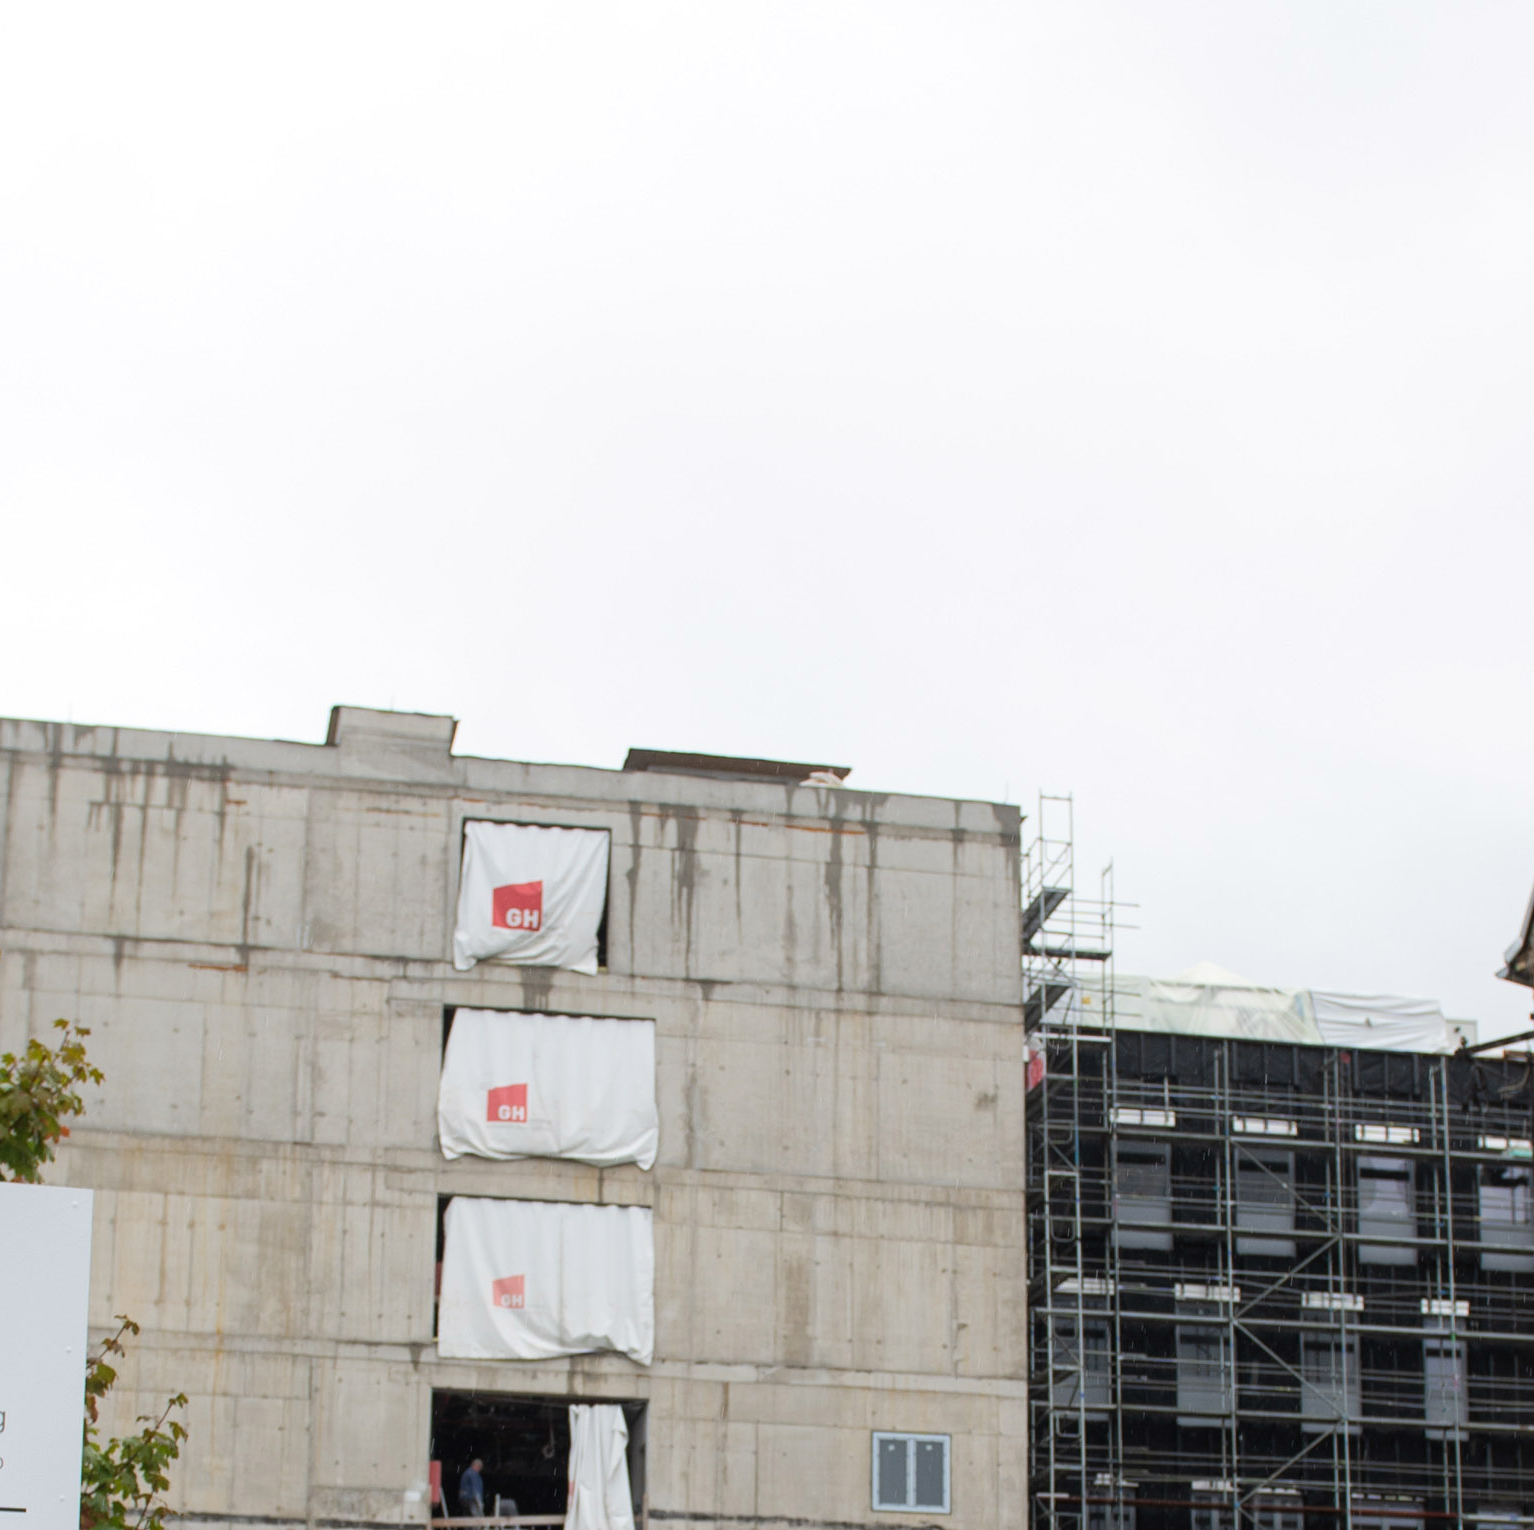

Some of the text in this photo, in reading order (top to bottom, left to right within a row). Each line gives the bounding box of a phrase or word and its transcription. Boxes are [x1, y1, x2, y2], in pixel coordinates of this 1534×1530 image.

[506, 908, 538, 928] GH
[498, 1105, 524, 1121] GH
[501, 1294, 523, 1307] GH
